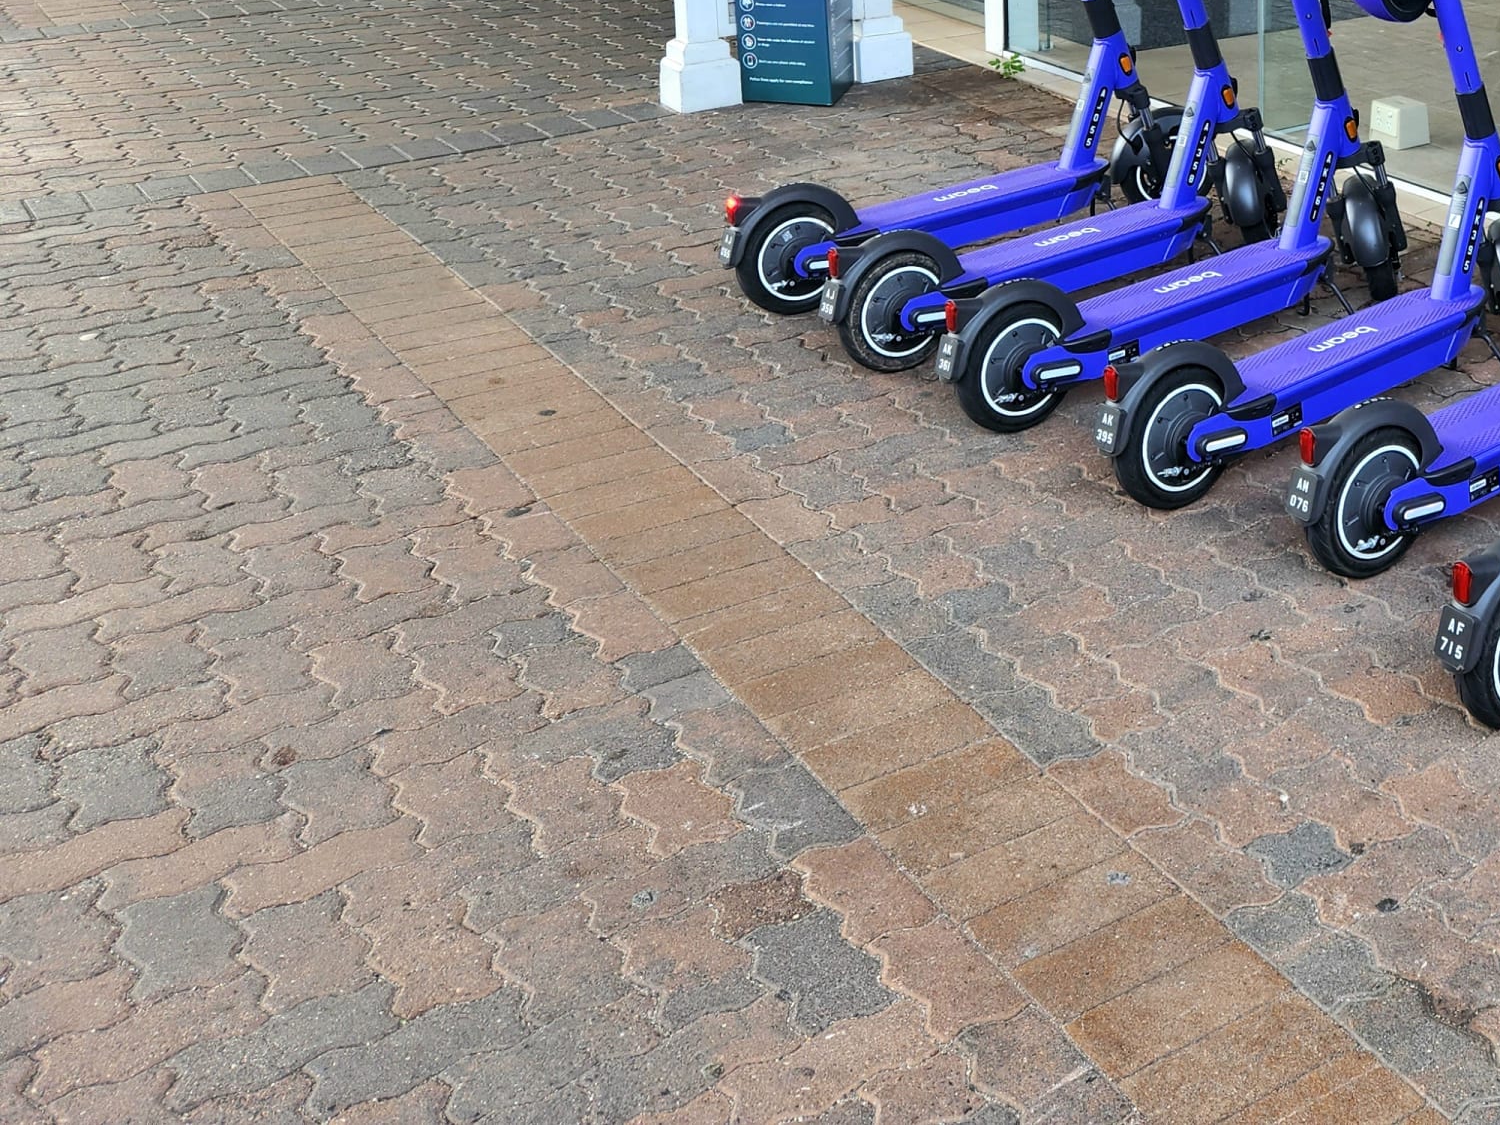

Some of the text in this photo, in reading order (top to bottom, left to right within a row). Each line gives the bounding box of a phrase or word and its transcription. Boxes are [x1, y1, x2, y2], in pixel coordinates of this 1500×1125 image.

[932, 184, 999, 202] beam
[1034, 227, 1102, 247] beam
[1154, 271, 1222, 293] beam
[826, 288, 836, 300] AJ
[1308, 326, 1379, 352] beam
[942, 343, 953, 355] AK
[1101, 412, 1114, 427] AK
[1095, 428, 1114, 445] 395
[1289, 494, 1310, 513] 076
[1448, 617, 1466, 636] AF
[1440, 636, 1464, 661] 715
